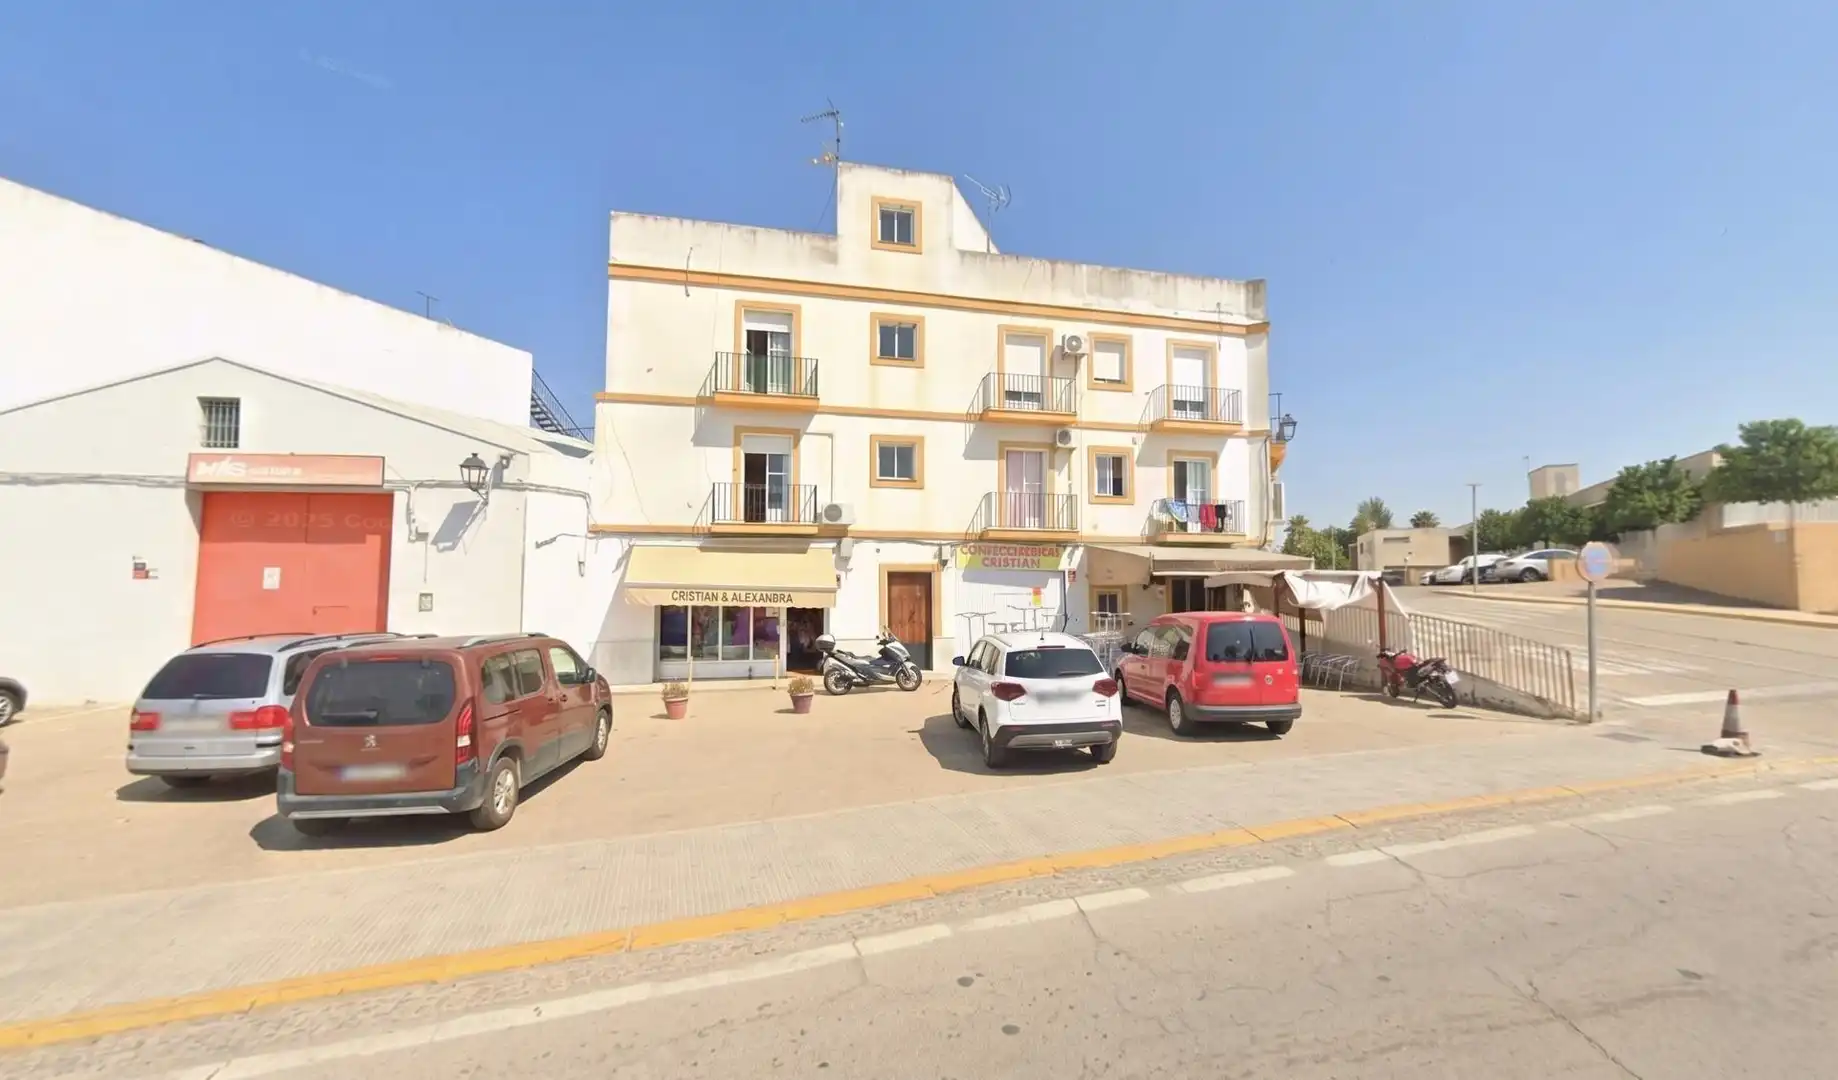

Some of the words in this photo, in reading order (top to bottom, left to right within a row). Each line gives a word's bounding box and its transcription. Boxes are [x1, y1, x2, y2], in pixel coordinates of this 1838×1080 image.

[982, 557, 1041, 569] CRISTIAN
[671, 590, 719, 602] CRISTIAN
[721, 592, 729, 602] &
